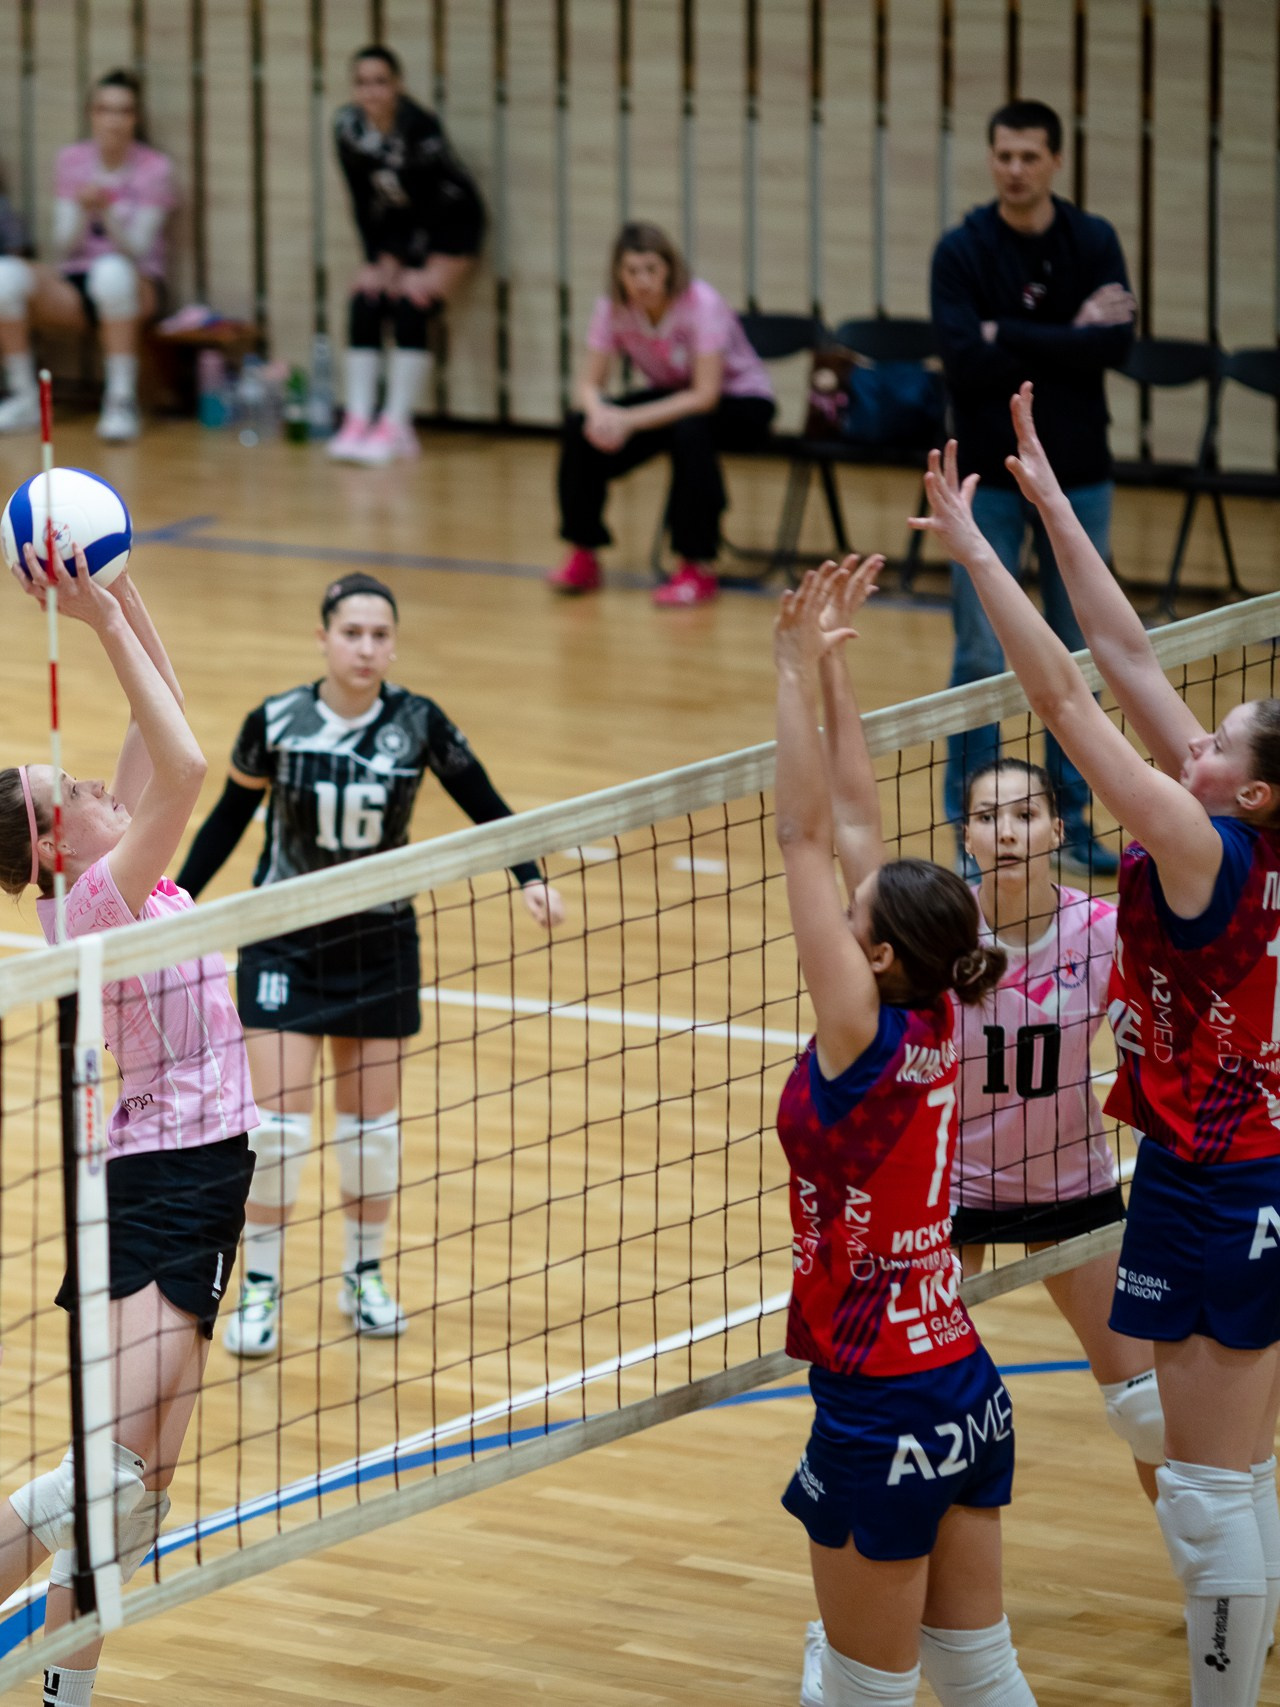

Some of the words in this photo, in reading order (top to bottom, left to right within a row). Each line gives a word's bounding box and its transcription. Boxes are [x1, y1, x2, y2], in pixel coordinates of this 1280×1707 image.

[314, 780, 387, 851] 16
[1149, 966, 1173, 1064] A2MED
[982, 1023, 1061, 1098] 10
[927, 1084, 956, 1208] 7
[796, 1175, 822, 1276] A2MED
[1127, 1270, 1171, 1291] GLOBAL
[1127, 1284, 1162, 1301] VISION
[930, 1307, 964, 1332] GLO
[886, 1386, 1013, 1486] A2ME
